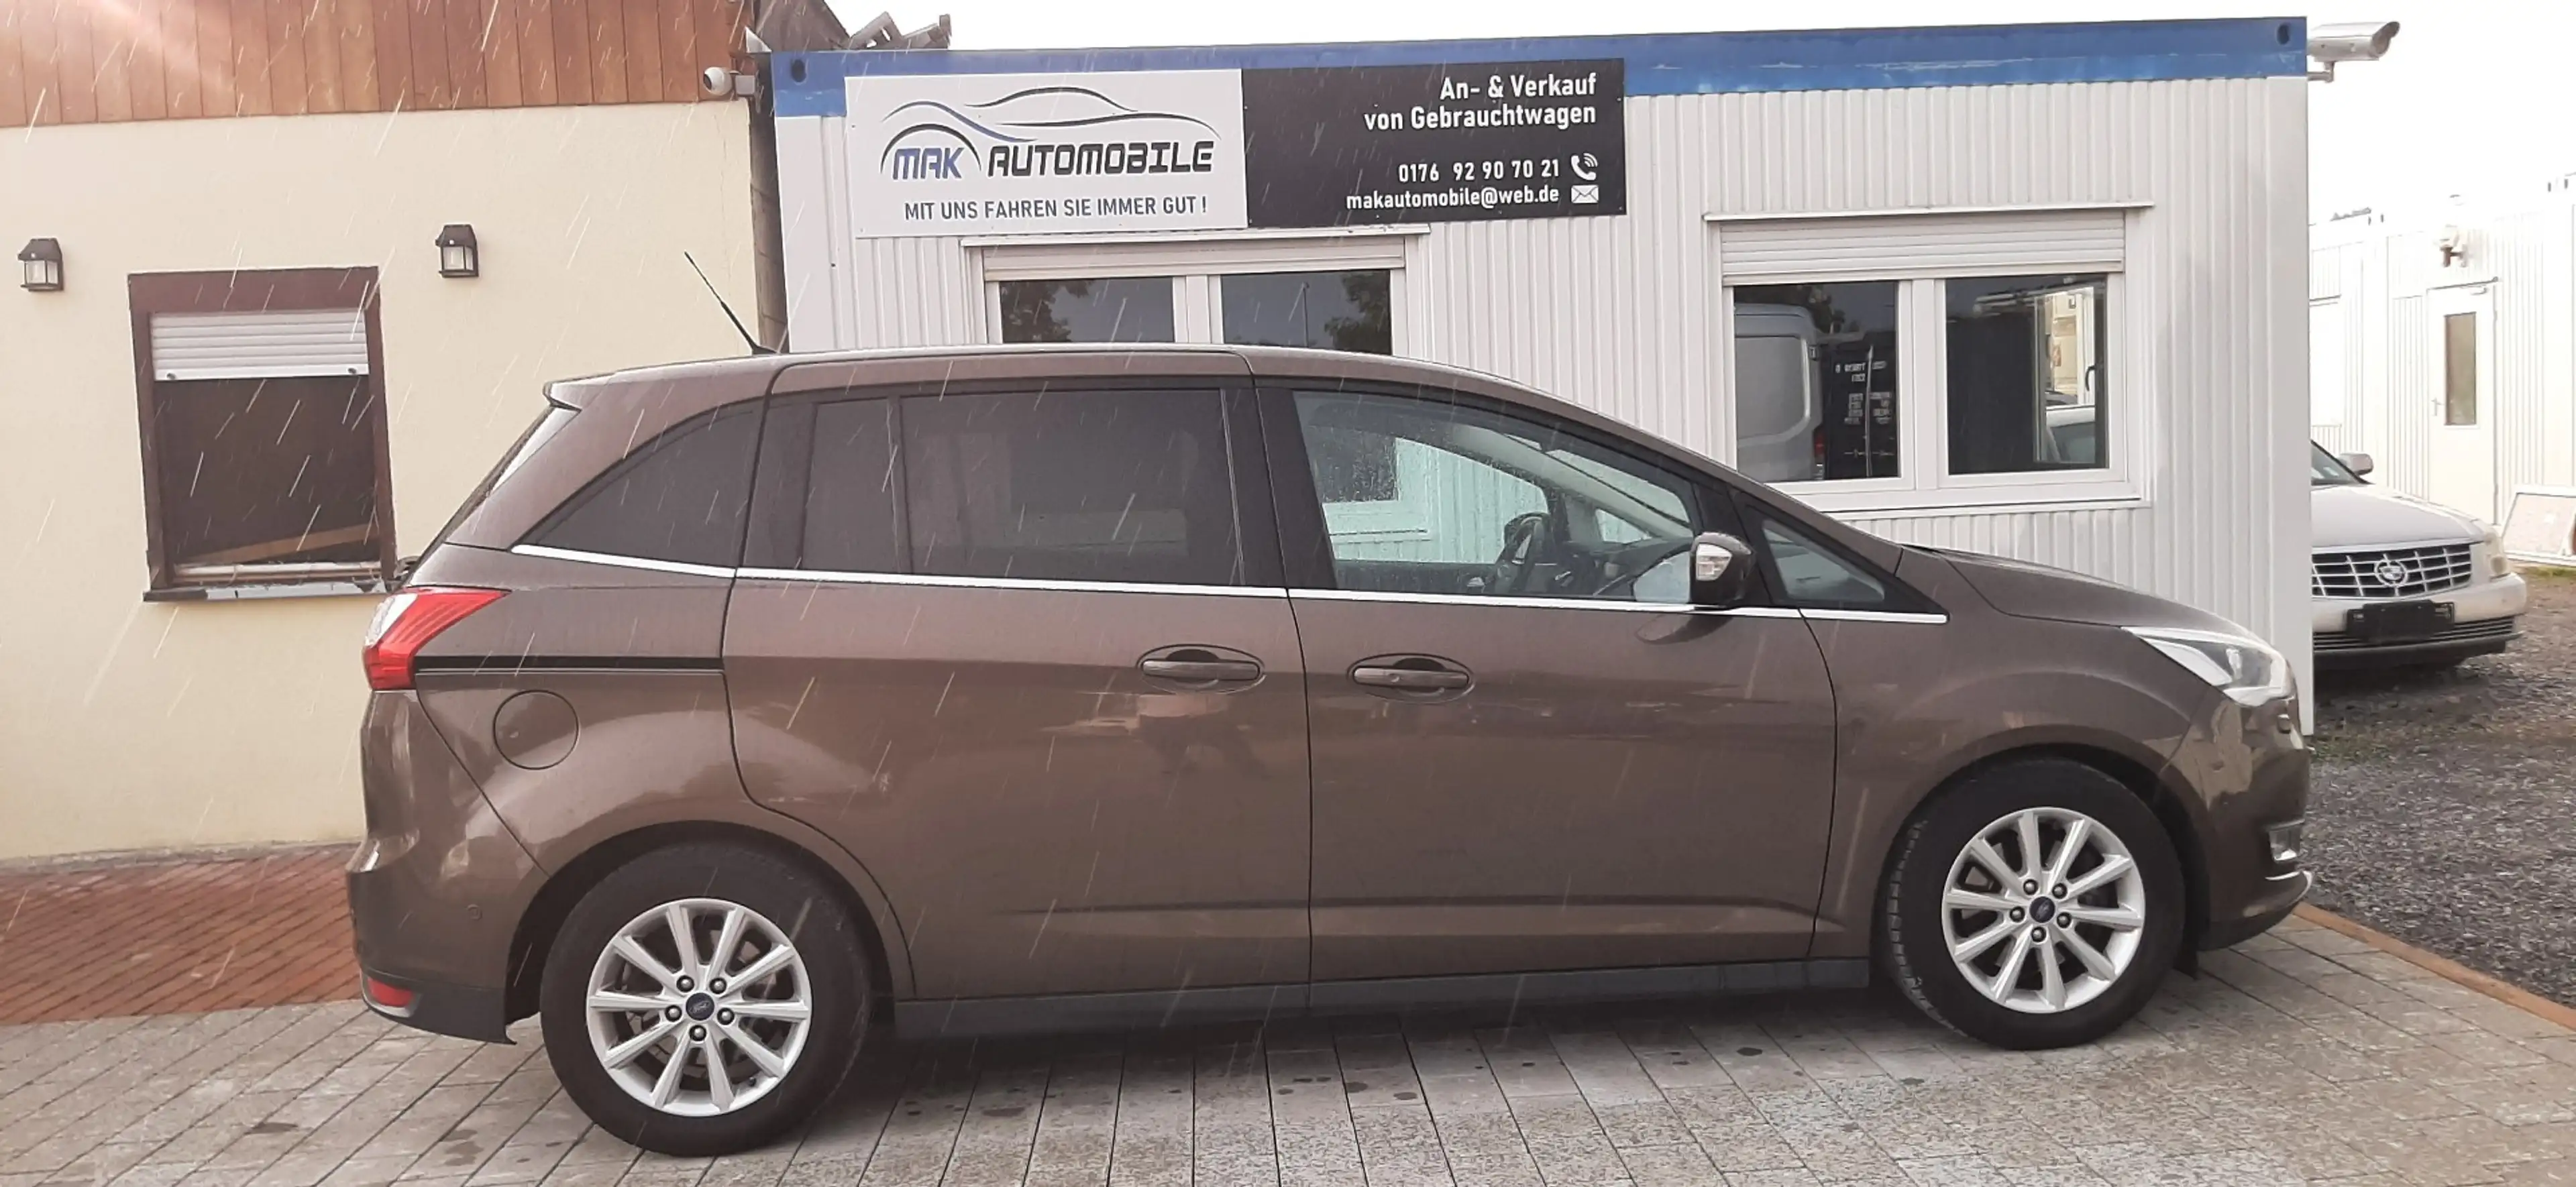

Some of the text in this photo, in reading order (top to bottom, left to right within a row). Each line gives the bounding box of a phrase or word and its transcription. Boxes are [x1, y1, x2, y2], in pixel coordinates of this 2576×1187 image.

[1440, 72, 1597, 100] An- & Verkauf
[1364, 104, 1597, 130] von Gebrauchtwagen
[892, 141, 1214, 180] MAK AUTOMOBILE
[1398, 160, 1559, 182] 0176 92 90 70 21
[904, 195, 1208, 220] MIT UNS FAHREN SIE IMMER GUT !
[1346, 184, 1560, 210] makautomobile@web.de
